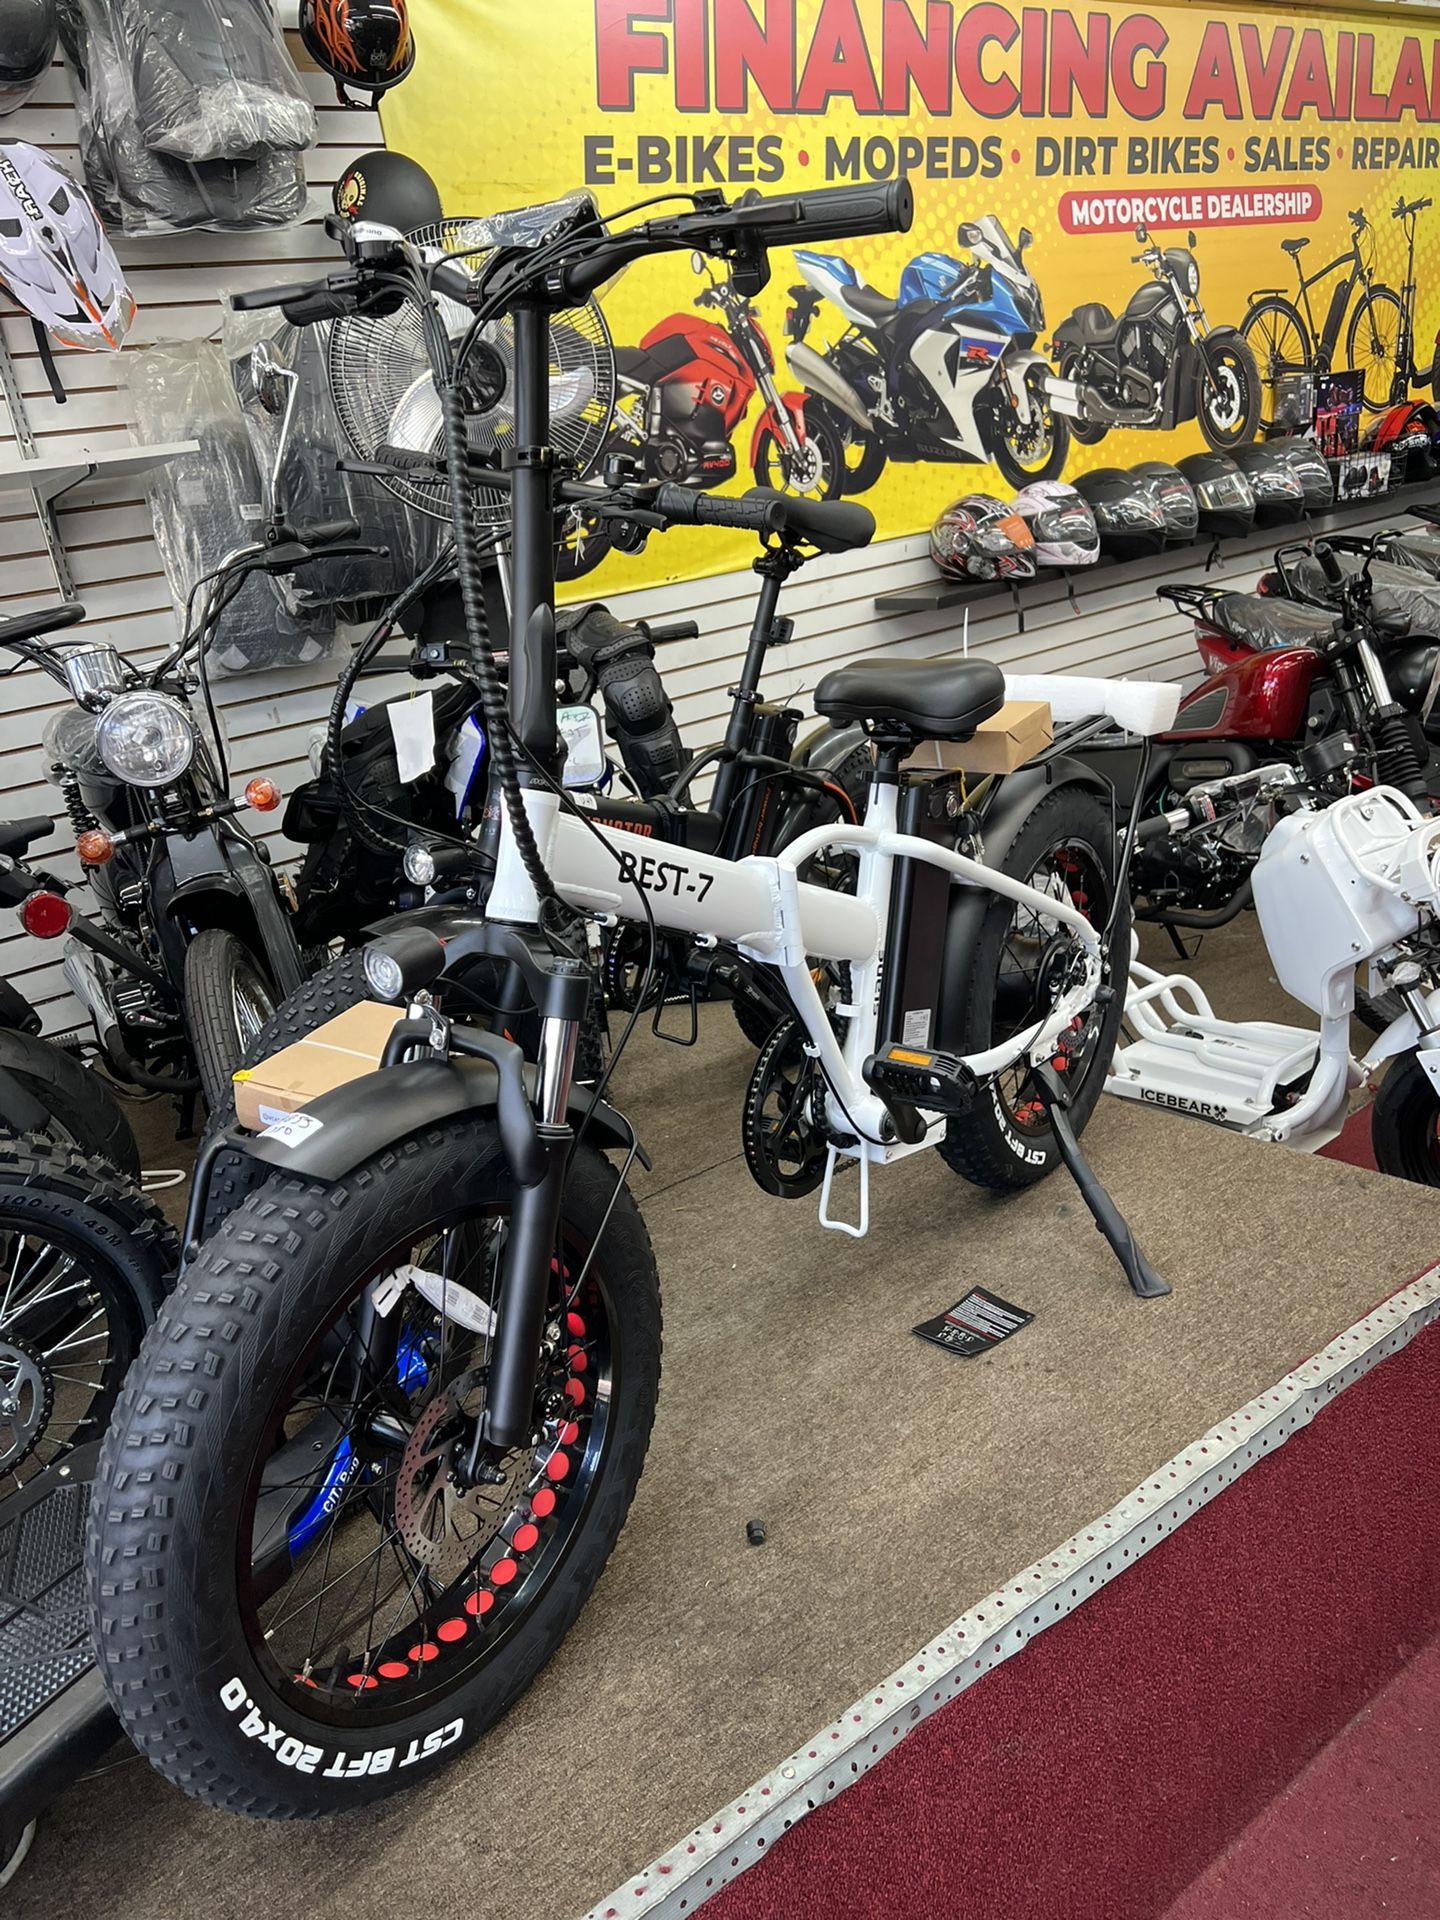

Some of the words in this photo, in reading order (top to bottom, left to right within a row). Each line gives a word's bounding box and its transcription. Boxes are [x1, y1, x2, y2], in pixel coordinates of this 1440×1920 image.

[594, 0, 1169, 121] FINANCING
[1183, 21, 1440, 123] AVAILA
[584, 135, 784, 185] E-BIKES
[825, 135, 1002, 181] MOPEDS
[1035, 136, 1118, 177] DIRT
[1127, 136, 1219, 175] BIKES
[1244, 136, 1330, 172] SALES
[1071, 196, 1203, 226] MOTORCYCLE
[1207, 191, 1313, 220] DEALERSHIP
[618, 850, 714, 903] BEST-7
[1140, 1088, 1212, 1116] ICEBEAR
[1005, 1130, 1025, 1158] BFT
[1025, 1149, 1046, 1165] CST
[219, 1677, 324, 1774] 20X4.0
[399, 1717, 464, 1768] CST
[322, 1747, 396, 1778] BFT
